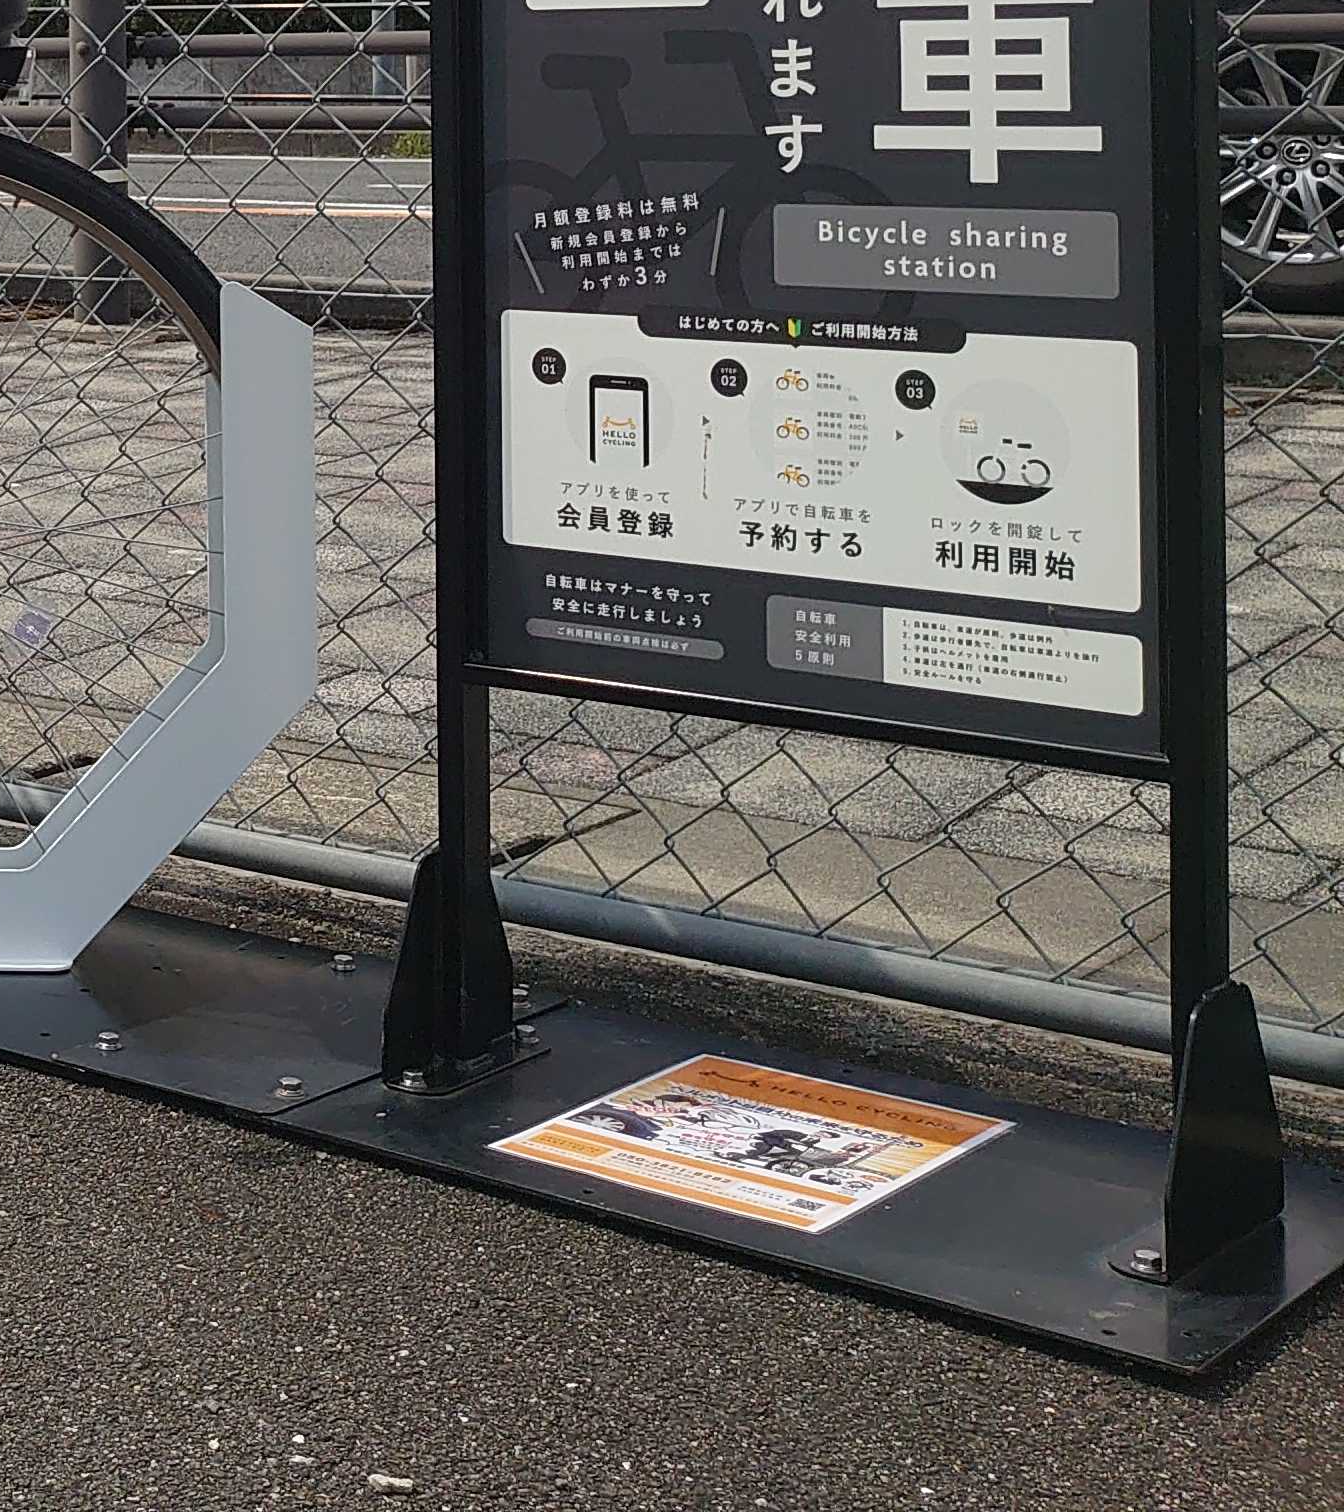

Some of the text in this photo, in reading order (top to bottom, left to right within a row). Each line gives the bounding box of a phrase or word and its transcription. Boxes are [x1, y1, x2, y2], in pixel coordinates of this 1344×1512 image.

[533, 192, 700, 229] 月額登録料は無料
[550, 222, 688, 251] 新規会員登録から
[817, 220, 1068, 256] Bicycle sharing
[561, 244, 682, 270] 利用開始までは
[883, 255, 997, 280] station
[582, 266, 667, 291] わずか3分
[679, 315, 919, 342] はじめての方へ ご利用開始方法
[541, 363, 556, 375] 01
[720, 375, 737, 387] 02
[906, 387, 924, 399] 03
[602, 430, 636, 439] HELLO
[561, 481, 671, 504] アプリを使って
[557, 502, 674, 539] 会員登録
[733, 497, 872, 524] アプリで自転車を
[739, 521, 864, 558] 予約する
[935, 541, 1077, 581] 利用開始
[545, 573, 712, 606] 自転車はマナーを守って
[551, 597, 703, 628] 安全に走行しましょう
[795, 609, 838, 626] 自転車
[794, 629, 852, 649] 安全利用
[772, 1085, 957, 1132] HELLO CYCLING
